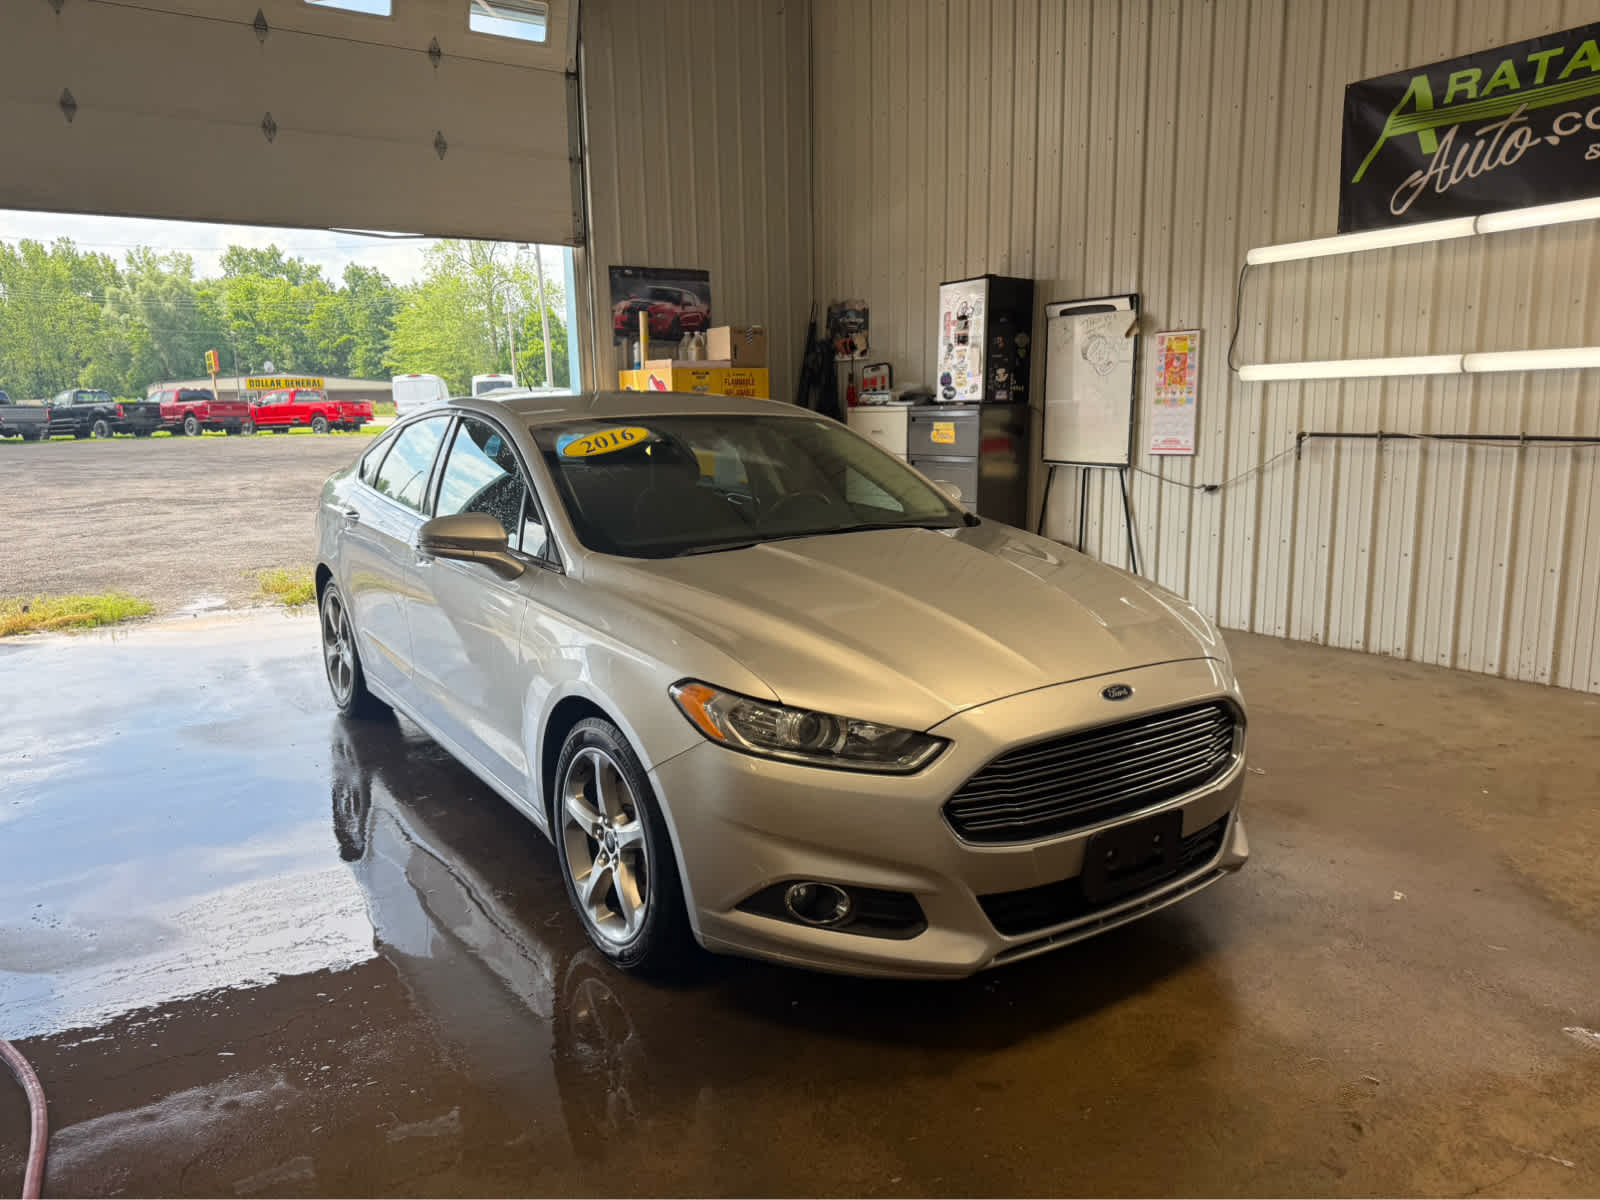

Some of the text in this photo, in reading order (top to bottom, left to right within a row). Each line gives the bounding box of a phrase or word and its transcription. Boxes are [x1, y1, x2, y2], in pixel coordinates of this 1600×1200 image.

[249, 379, 321, 388] DOLLAR GENERAL
[580, 429, 635, 453] 2016
